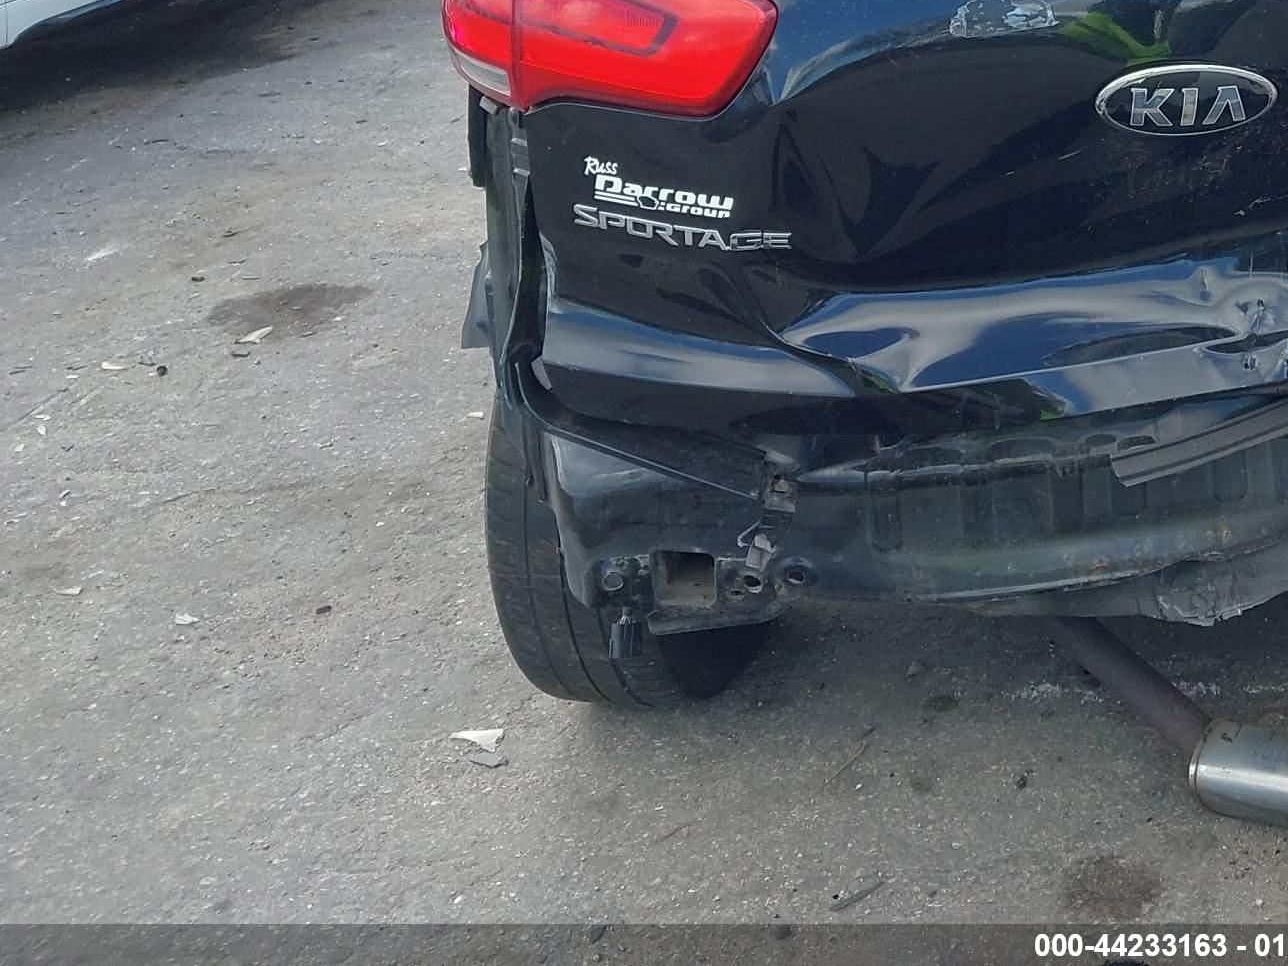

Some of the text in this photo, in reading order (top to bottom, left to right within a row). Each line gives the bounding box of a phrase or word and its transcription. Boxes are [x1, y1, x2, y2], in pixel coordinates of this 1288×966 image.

[1129, 85, 1247, 128] KIA
[583, 155, 619, 176] Russ
[594, 173, 735, 211] Darrow
[572, 203, 793, 252] SPORTAGE
